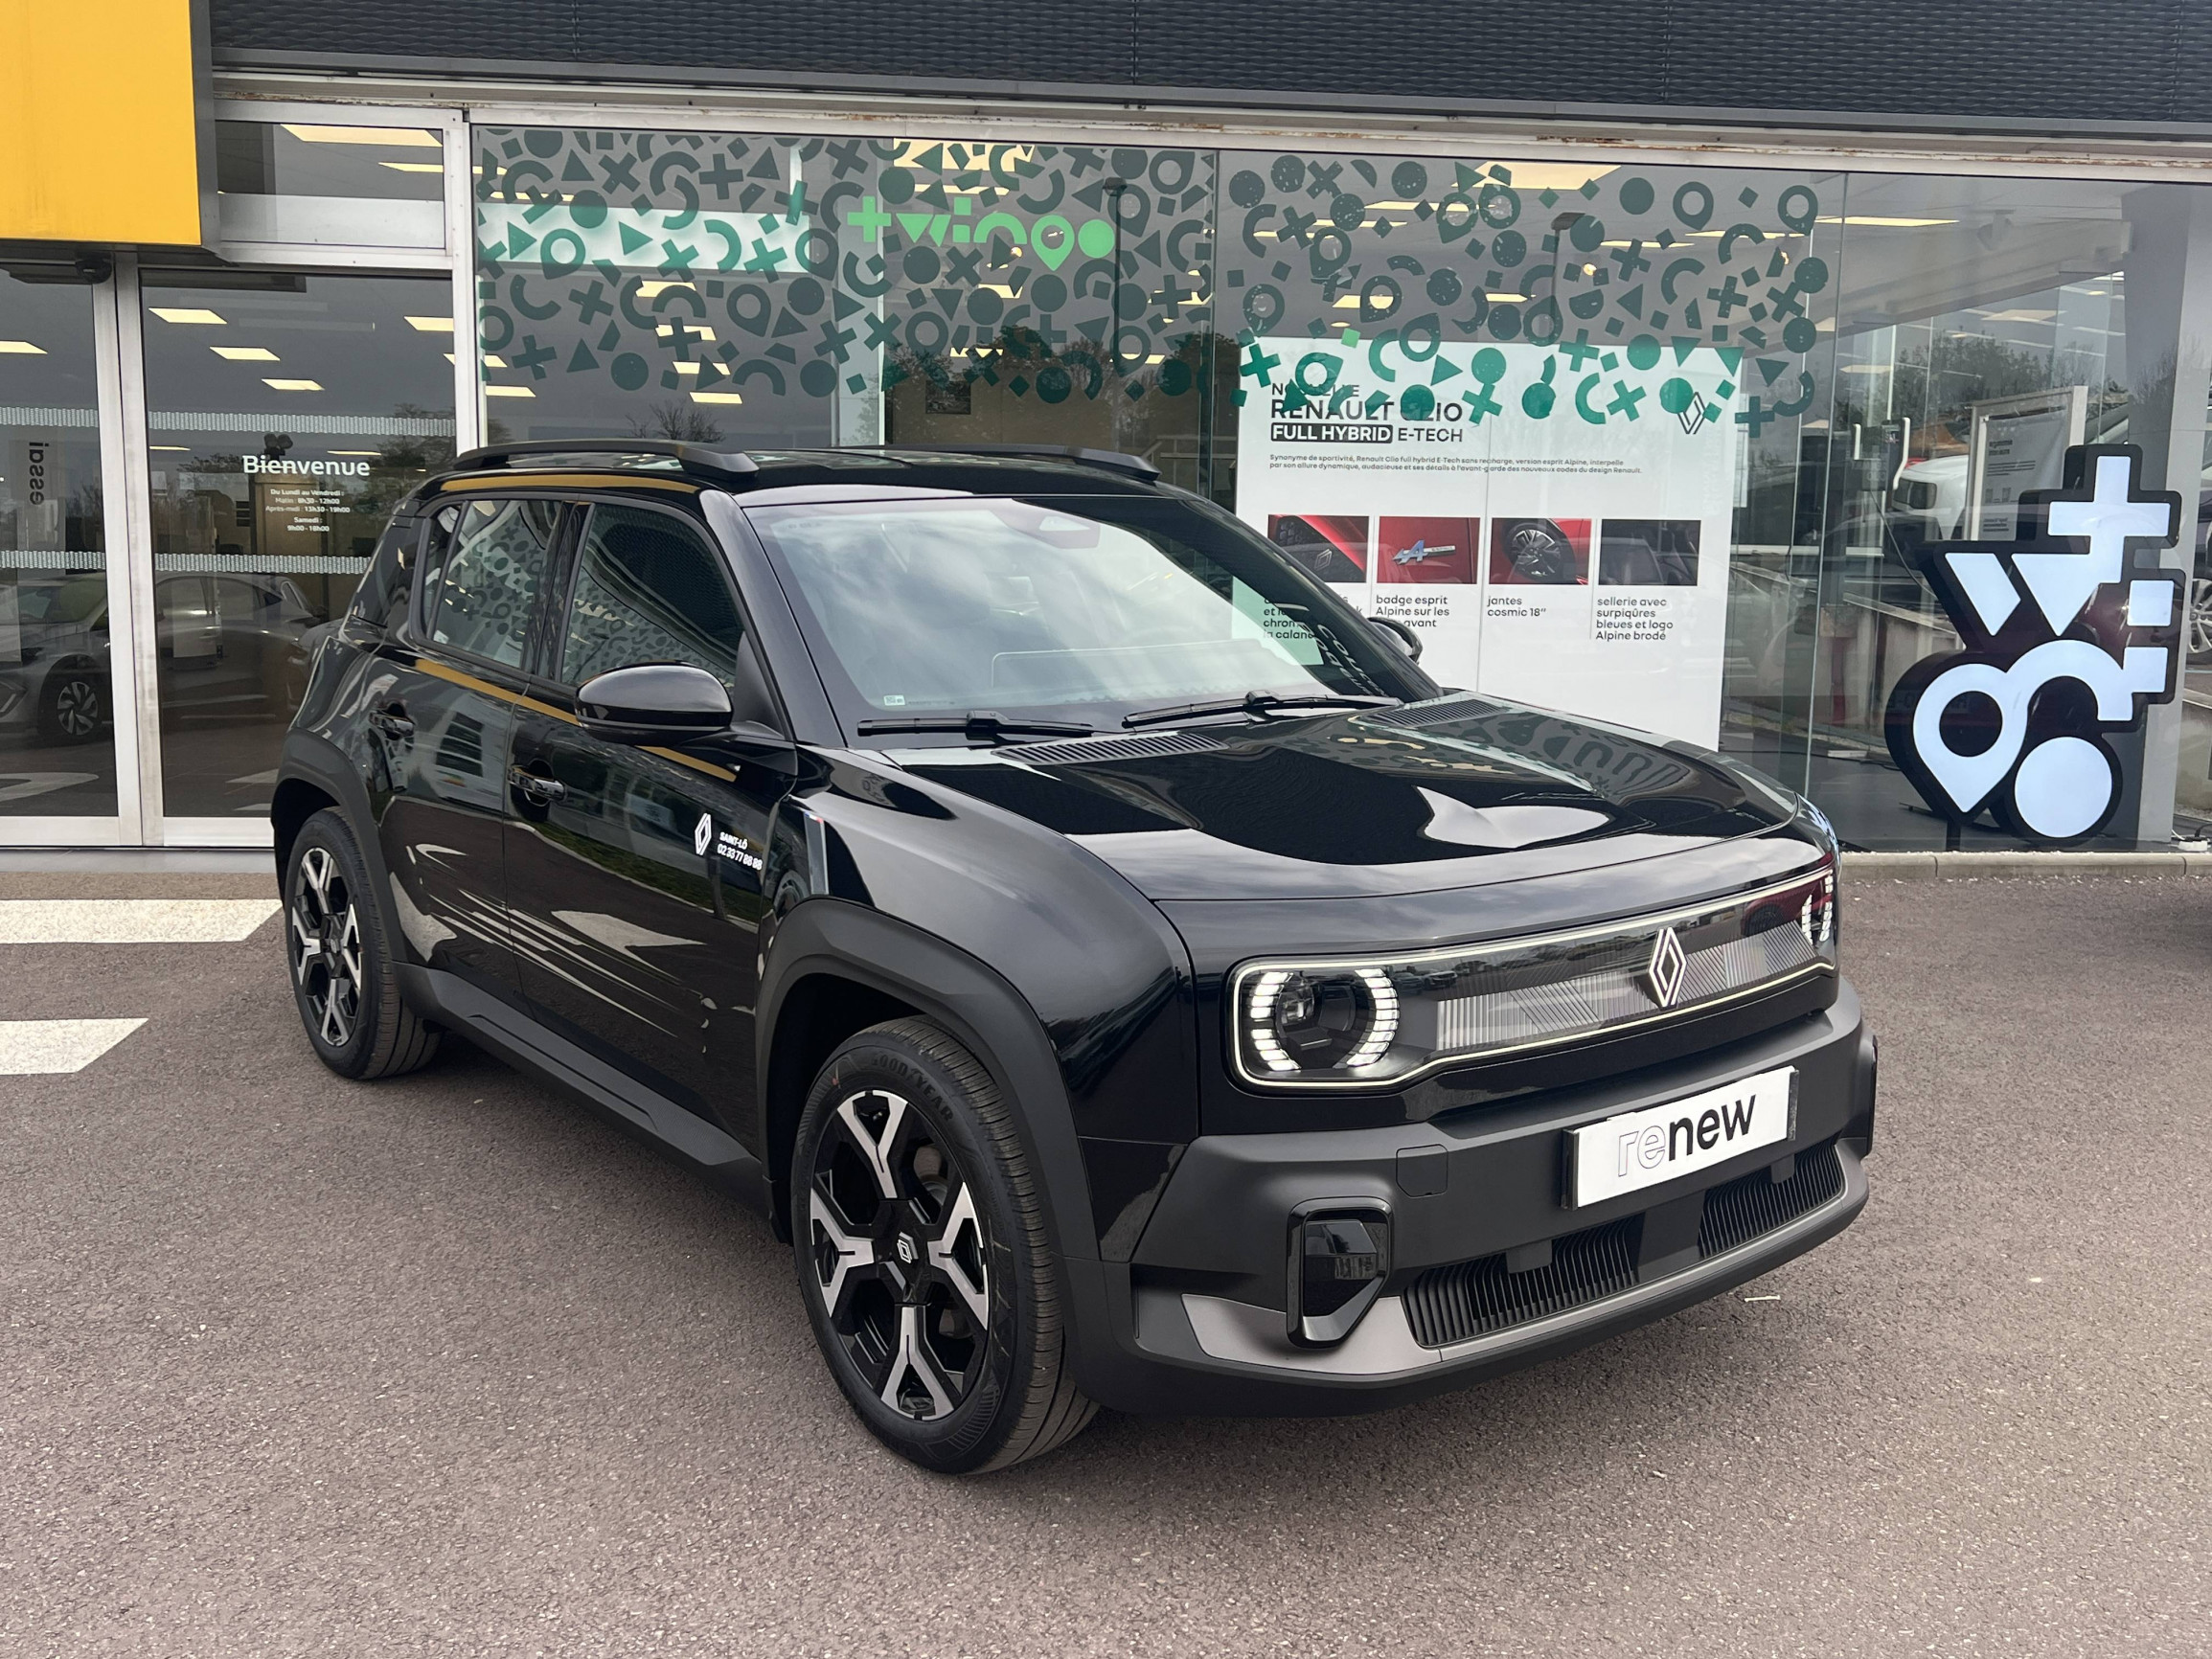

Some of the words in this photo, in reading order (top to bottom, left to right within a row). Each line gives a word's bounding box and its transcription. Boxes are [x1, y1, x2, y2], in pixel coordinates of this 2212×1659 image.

[1273, 424, 1318, 441] FULL
[1321, 425, 1391, 442] HYBRID
[1398, 427, 1463, 443] E-TECH
[242, 455, 371, 476] Bienvenue
[1269, 453, 1308, 462] Synonyme
[1318, 454, 1355, 464] sportivité,
[1589, 459, 1624, 467] interpelle
[1318, 462, 1360, 471] dynamique,
[1588, 466, 1612, 475] design
[1376, 595, 1413, 605] badge
[1414, 595, 1448, 605] esprit
[1487, 596, 1522, 607] jantes
[1597, 597, 1638, 606] sellerie
[1376, 606, 1412, 618] Alpine
[1413, 608, 1432, 617] sur
[1433, 607, 1450, 617] les
[1487, 607, 1528, 617] cosmic
[1596, 607, 1656, 620] surpiqûres
[1403, 619, 1438, 627] avant
[1596, 620, 1632, 629] bleues
[1634, 621, 1647, 629] et
[1649, 621, 1674, 631] logo
[1596, 631, 1631, 642] Alpine
[1633, 630, 1667, 641] brodé
[719, 831, 747, 850] SAINT-LÔ
[718, 844, 727, 855] 02
[735, 851, 744, 862] 77
[1617, 1094, 1757, 1177] renew
